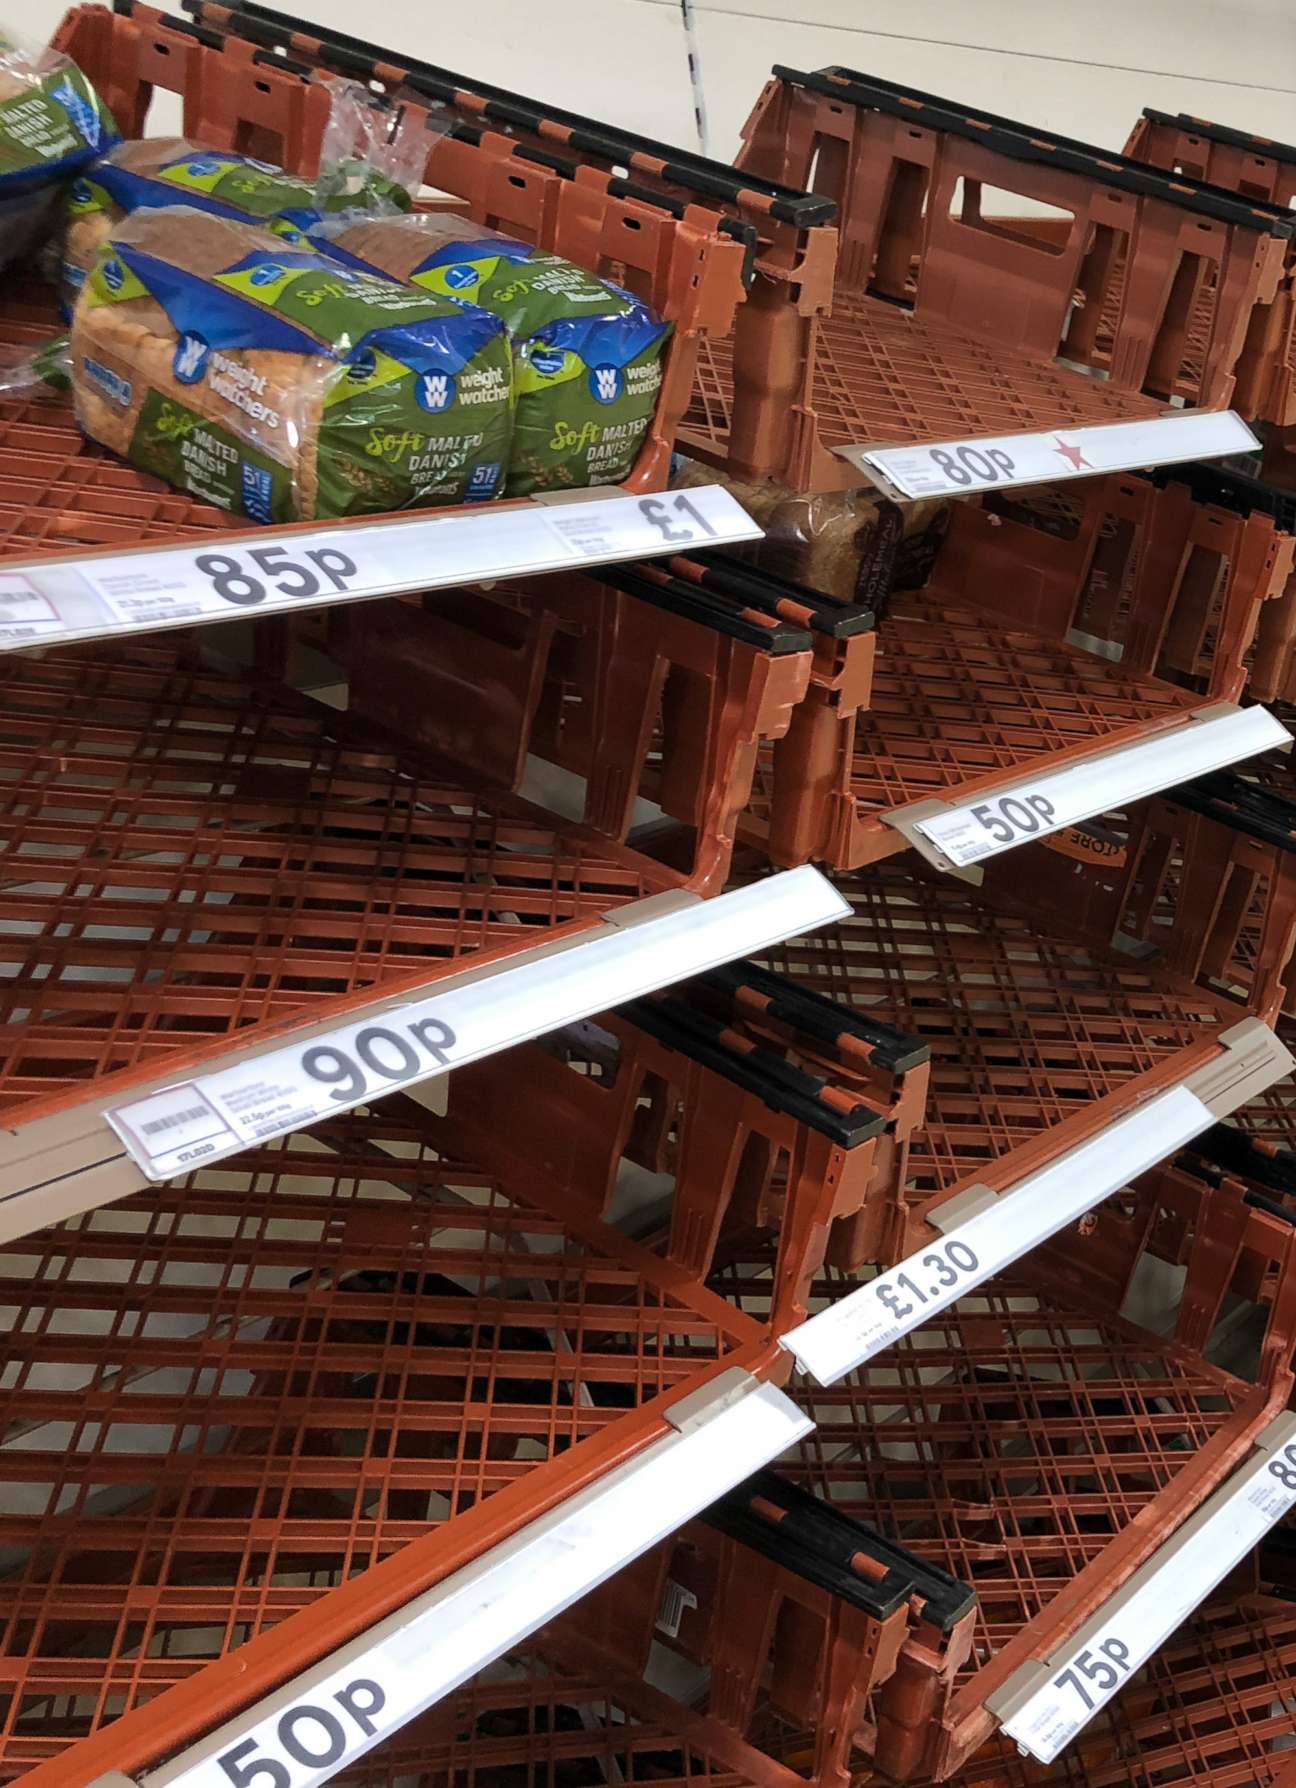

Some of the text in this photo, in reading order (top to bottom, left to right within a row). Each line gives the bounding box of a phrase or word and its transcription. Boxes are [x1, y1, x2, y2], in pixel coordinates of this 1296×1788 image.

[459, 384, 510, 406] watche
[460, 367, 504, 389] weight
[365, 427, 424, 463] Soft
[550, 421, 600, 455] Soft
[929, 446, 1016, 486] 80p
[195, 546, 357, 605] 85p
[638, 495, 718, 541] £1
[970, 794, 1056, 842] 50p
[302, 1017, 457, 1101] 90p
[876, 1240, 979, 1319] £1.30
[1053, 1637, 1130, 1710] 75p
[216, 1678, 386, 1788] 50p
